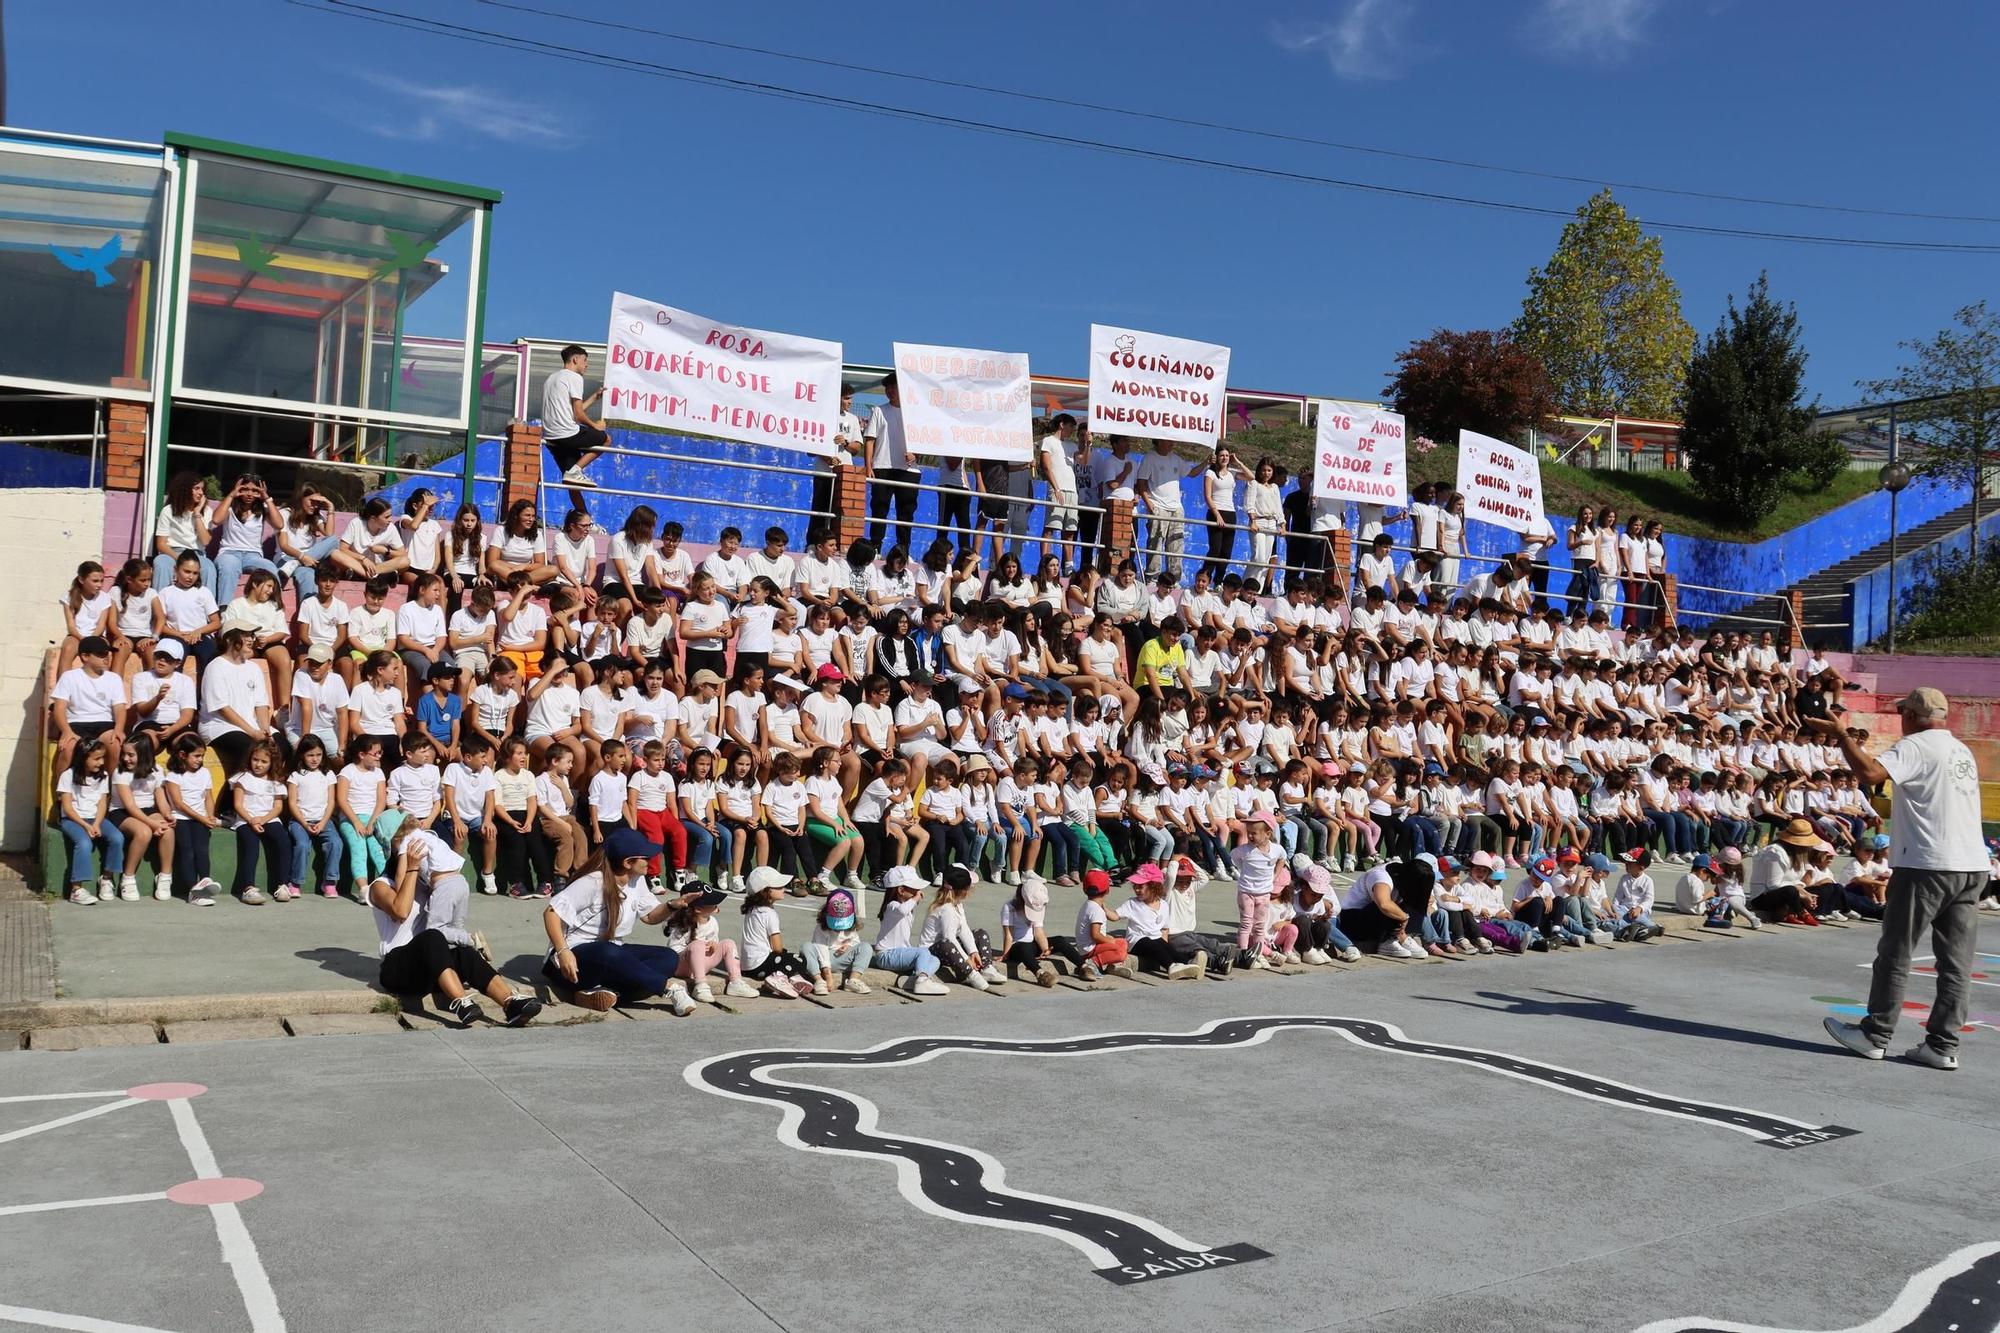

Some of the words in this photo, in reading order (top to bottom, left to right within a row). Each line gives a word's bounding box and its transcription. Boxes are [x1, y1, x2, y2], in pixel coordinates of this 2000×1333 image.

[705, 329, 768, 359] ROSA,
[612, 344, 772, 394] BOTARÉMOSTE
[795, 381, 818, 403] DE
[901, 353, 1021, 379] QUEREMOS
[1110, 351, 1215, 380] COCIÑANDO
[907, 386, 919, 405] A
[1112, 380, 1209, 407] MOMENTOS
[1096, 405, 1215, 433] INESQUECIBLES
[1332, 415, 1351, 431] 46
[1371, 420, 1402, 438] ANOS
[907, 424, 944, 446] DAS
[1357, 437, 1376, 452] DE
[1322, 453, 1372, 473] SABOR
[1384, 462, 1393, 476] E
[1490, 452, 1515, 471] ROSA
[1327, 476, 1396, 497] AGARIMO
[1475, 473, 1511, 493] CHEIRA
[1517, 484, 1533, 499] QUE
[1478, 496, 1532, 522] ALIMENTA
[1773, 1130, 1841, 1147] META
